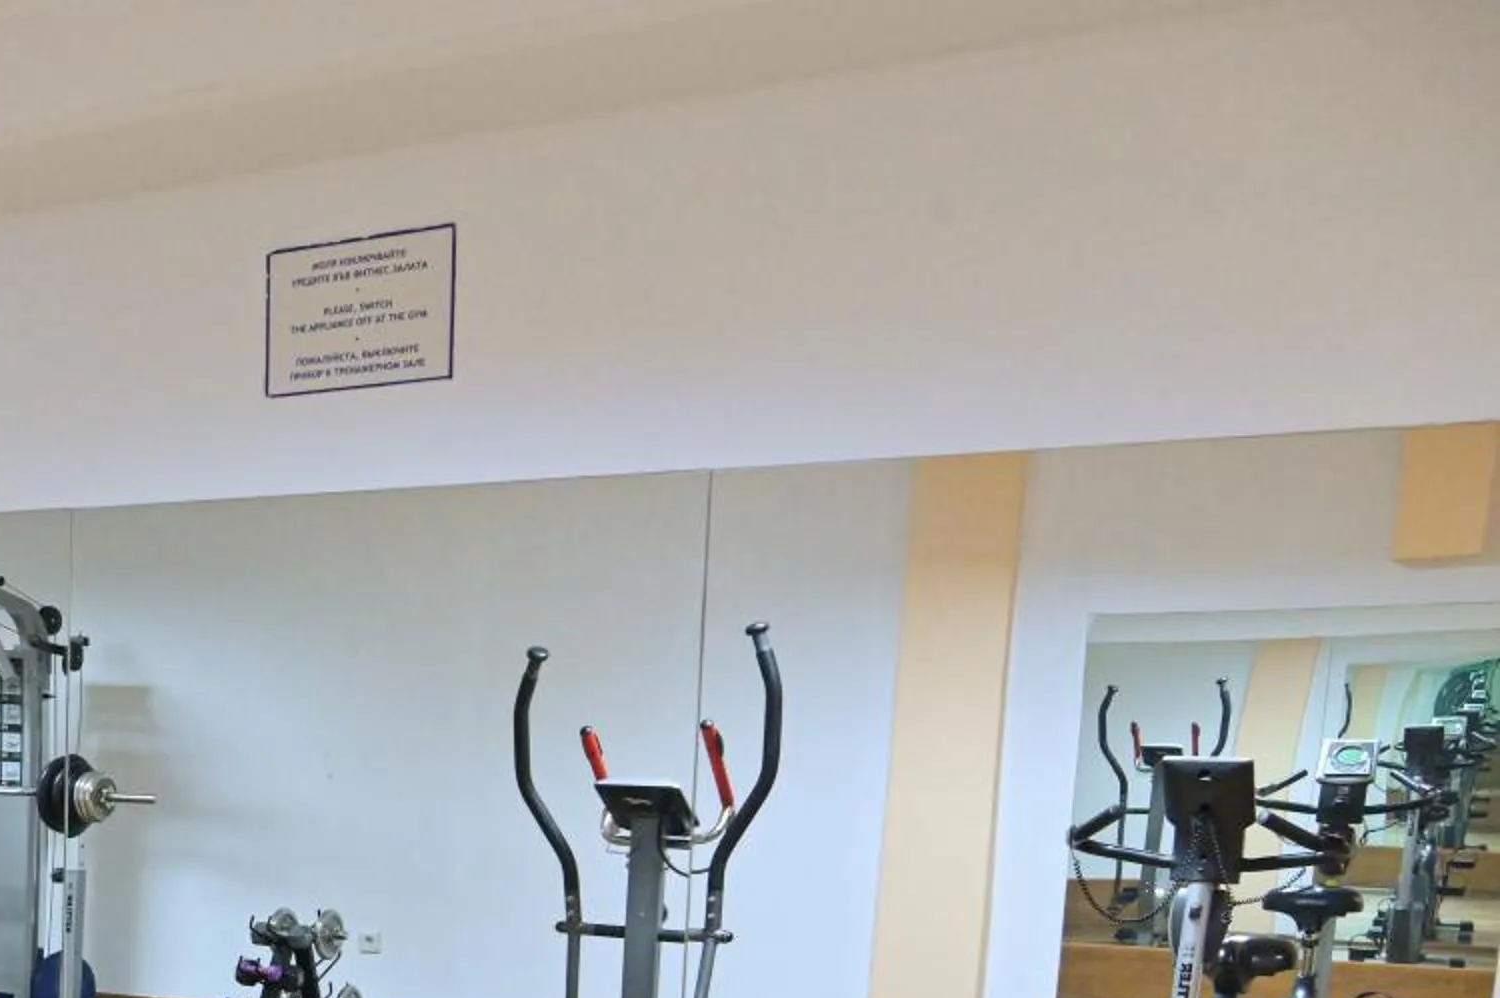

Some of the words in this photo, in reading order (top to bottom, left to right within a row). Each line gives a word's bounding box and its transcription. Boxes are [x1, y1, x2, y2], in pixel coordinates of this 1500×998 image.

[311, 259, 337, 271] МОЛЯ
[393, 260, 428, 273] ЗАЛАТА
[359, 299, 393, 311] SWITCH
[291, 324, 306, 335] THE
[308, 318, 353, 333] APPLIANCE
[355, 315, 373, 327] OFF
[375, 314, 386, 325] AT
[388, 312, 406, 323] THE
[407, 309, 428, 320] GYM
